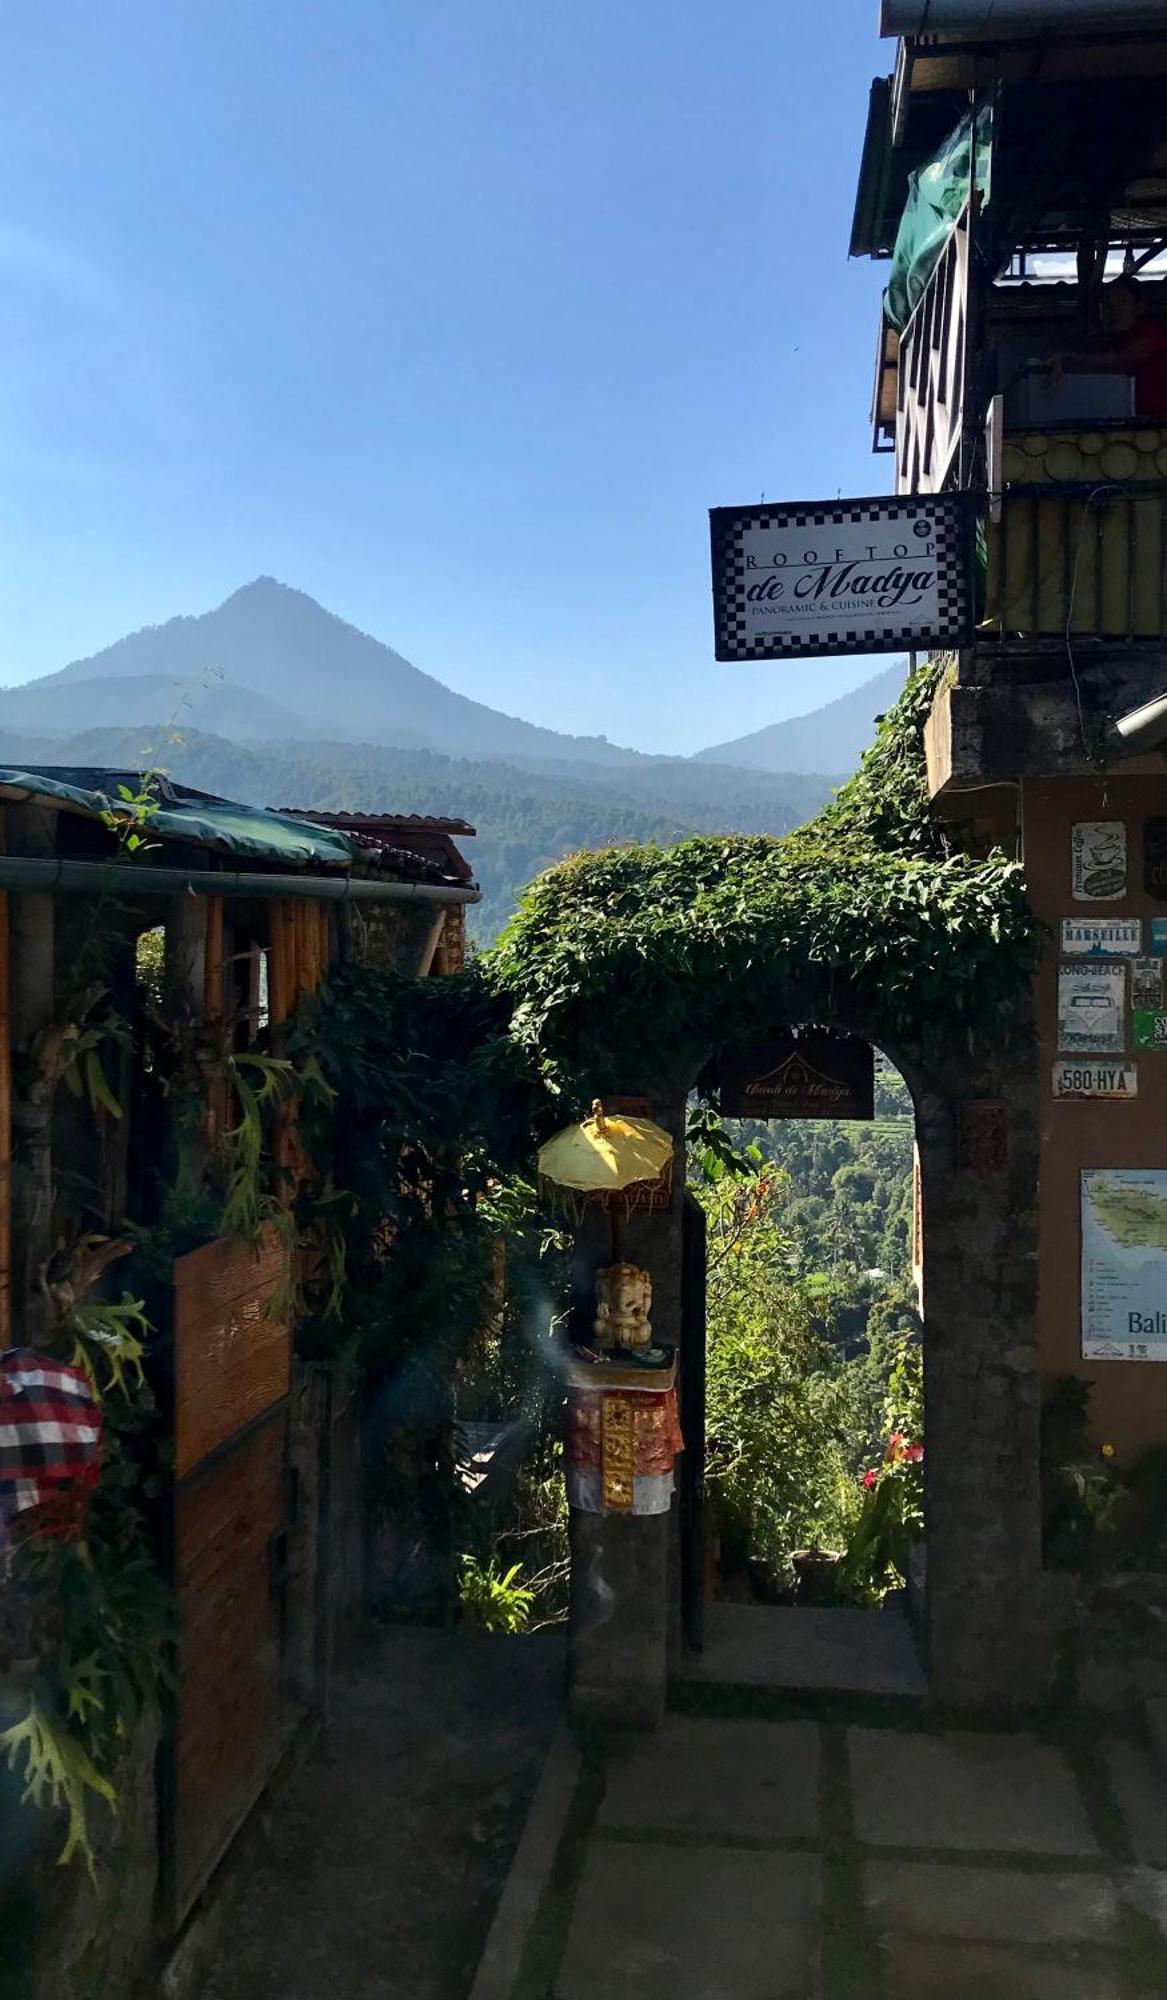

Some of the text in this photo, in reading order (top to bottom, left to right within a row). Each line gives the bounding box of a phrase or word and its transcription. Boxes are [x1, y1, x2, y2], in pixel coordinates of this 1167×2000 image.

[746, 543, 935, 568] ROOFTOP
[746, 562, 937, 608] de Madya
[752, 603, 817, 616] PANORAMIC
[819, 601, 829, 611] &
[1064, 929, 1138, 941] MARSEILLE
[1128, 1311, 1166, 1334] Bali
